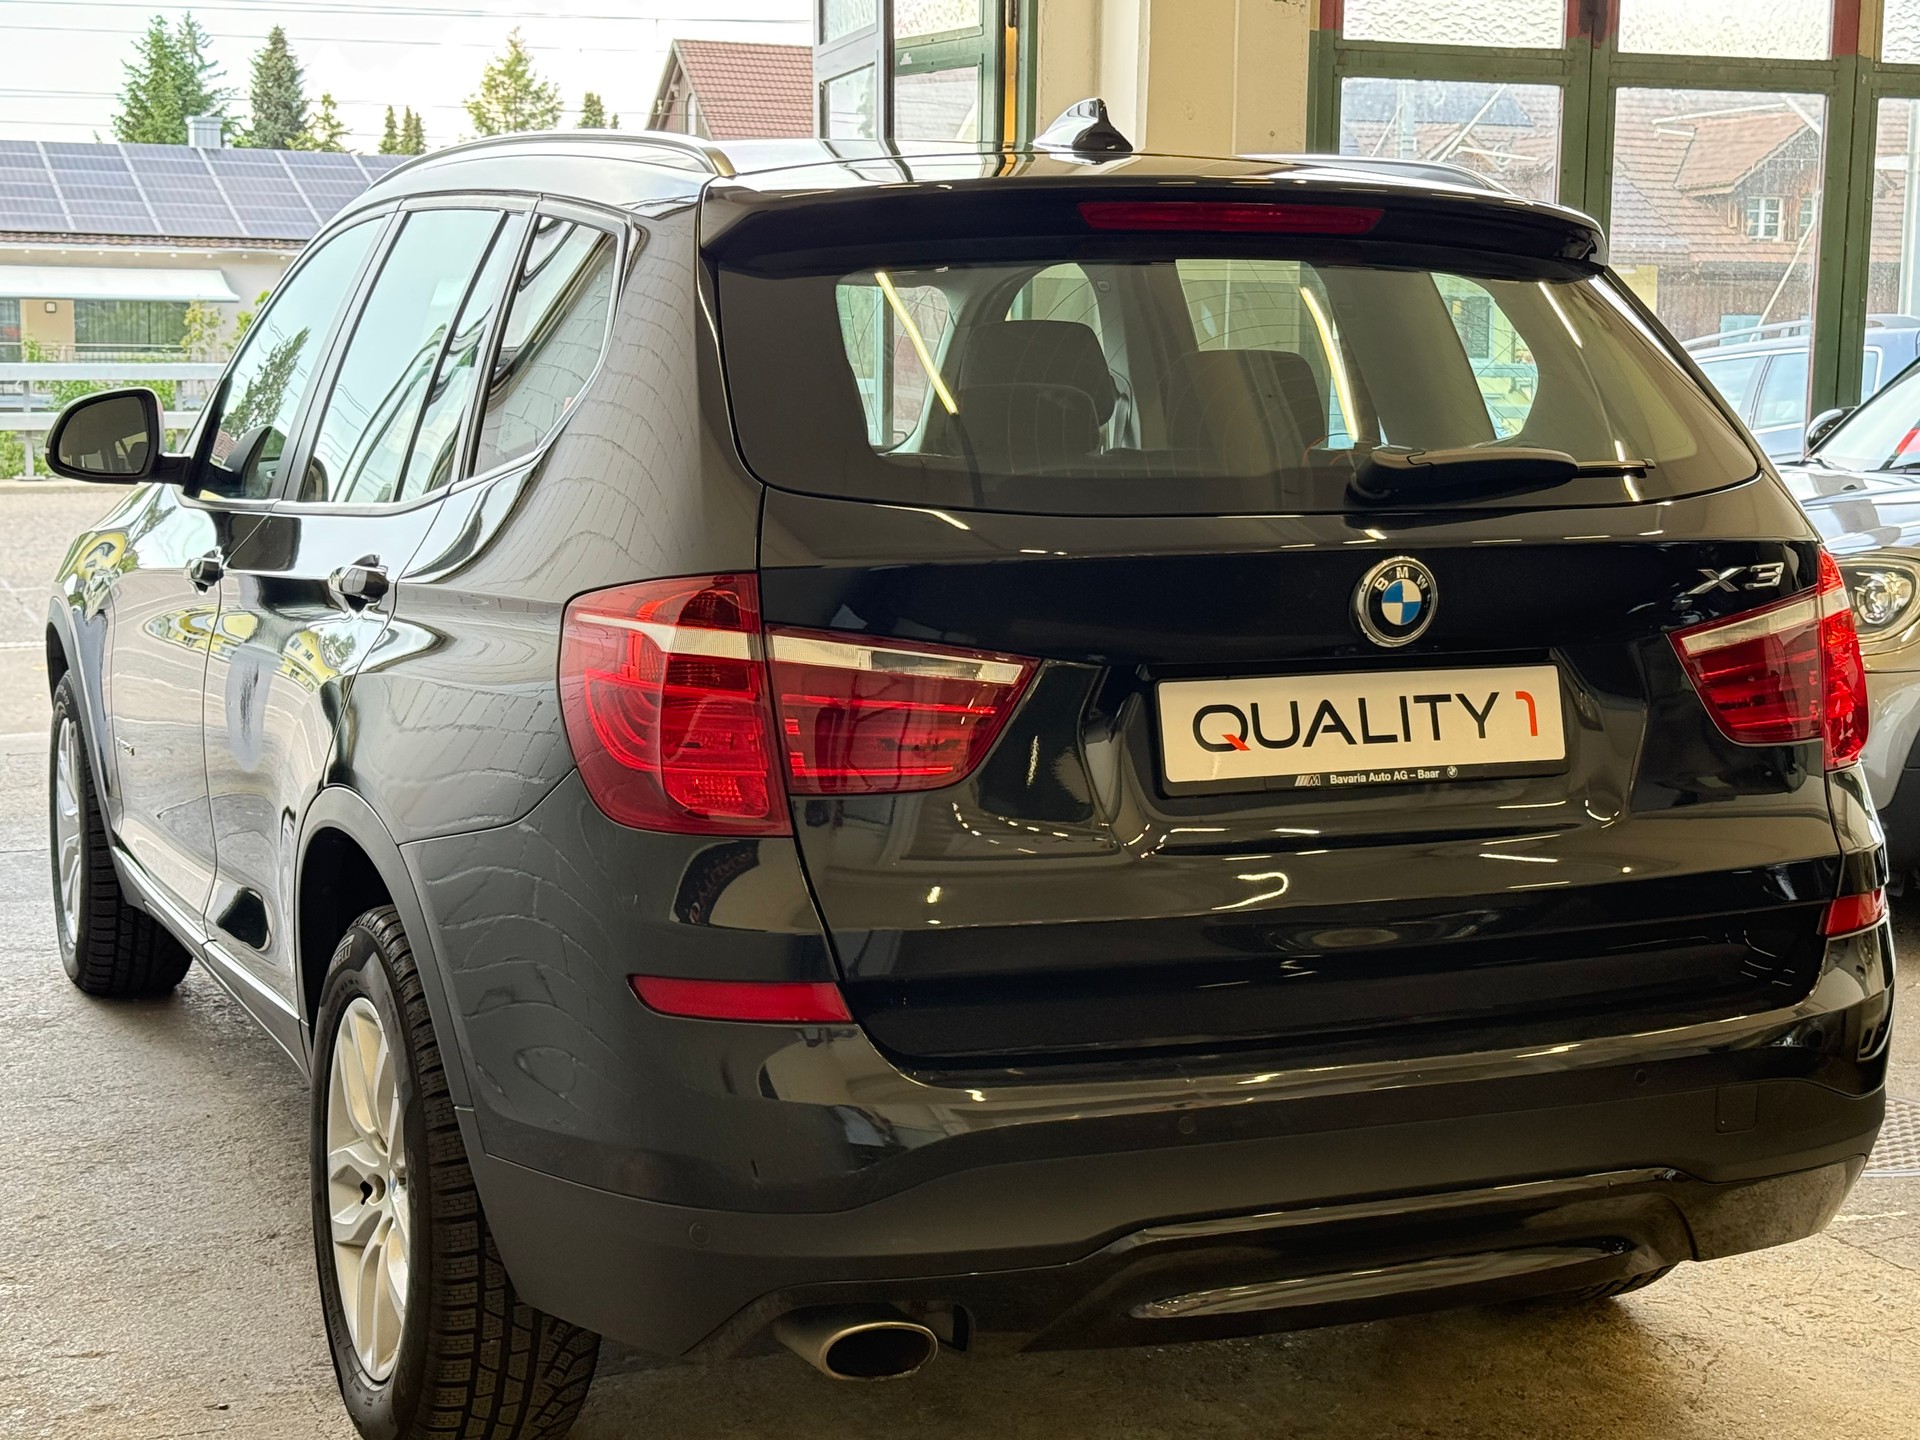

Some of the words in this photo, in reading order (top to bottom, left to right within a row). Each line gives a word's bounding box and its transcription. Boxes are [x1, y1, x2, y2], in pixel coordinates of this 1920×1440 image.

[1374, 567, 1428, 592] BMW
[1687, 562, 1785, 594] X3
[1192, 691, 1500, 753] QUALITY
[1330, 772, 1367, 785] Bavaria
[1368, 772, 1391, 783] Auto
[1393, 771, 1408, 781] AG
[1417, 769, 1440, 779] Baar
